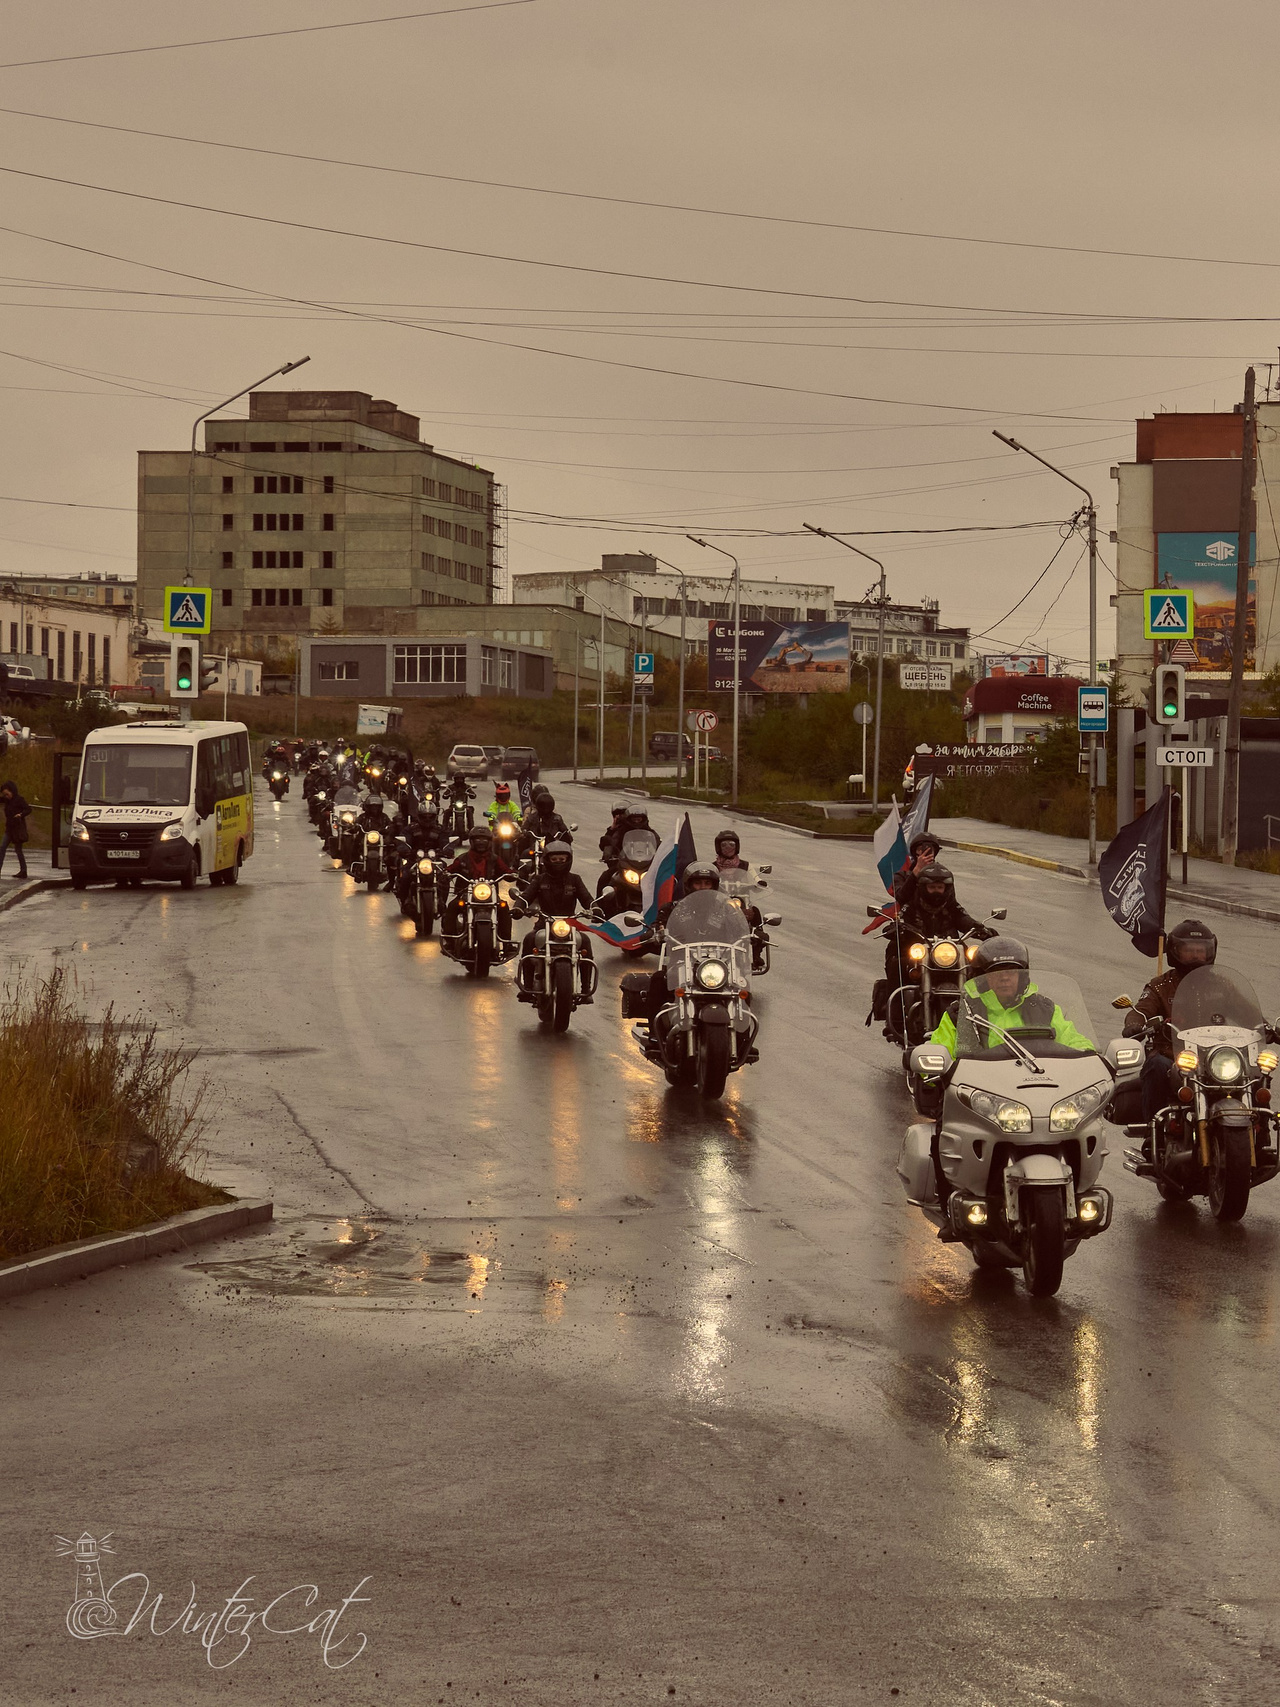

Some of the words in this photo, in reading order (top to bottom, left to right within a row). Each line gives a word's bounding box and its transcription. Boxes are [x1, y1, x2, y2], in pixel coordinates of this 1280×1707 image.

[905, 672, 947, 681] ЩЕБЕНЬ
[1020, 693, 1049, 702] Coffee
[1017, 701, 1052, 710] Machine
[934, 744, 949, 757] за
[952, 744, 985, 758] этим
[1165, 750, 1206, 764] СТОП
[106, 807, 173, 817] АвтоЛига
